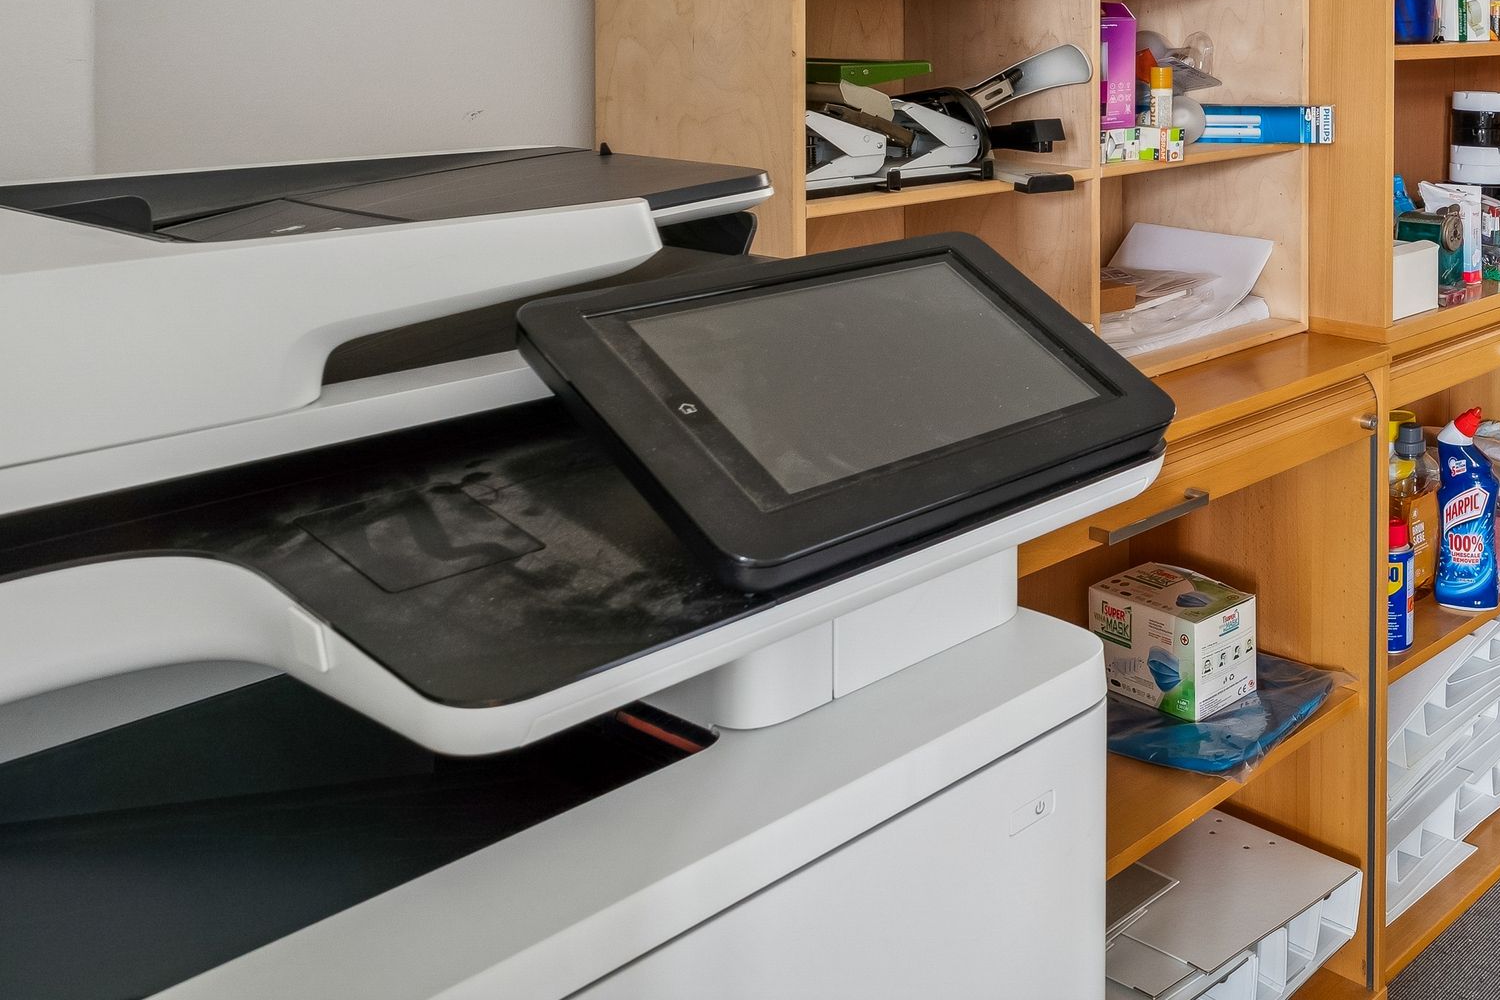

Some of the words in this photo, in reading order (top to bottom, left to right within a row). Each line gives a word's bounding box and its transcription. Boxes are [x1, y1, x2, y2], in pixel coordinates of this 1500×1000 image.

[1445, 493, 1480, 523] HARPIC
[1449, 533, 1483, 552] 100%
[1104, 605, 1126, 621] SUPER
[1106, 616, 1130, 638] MASK
